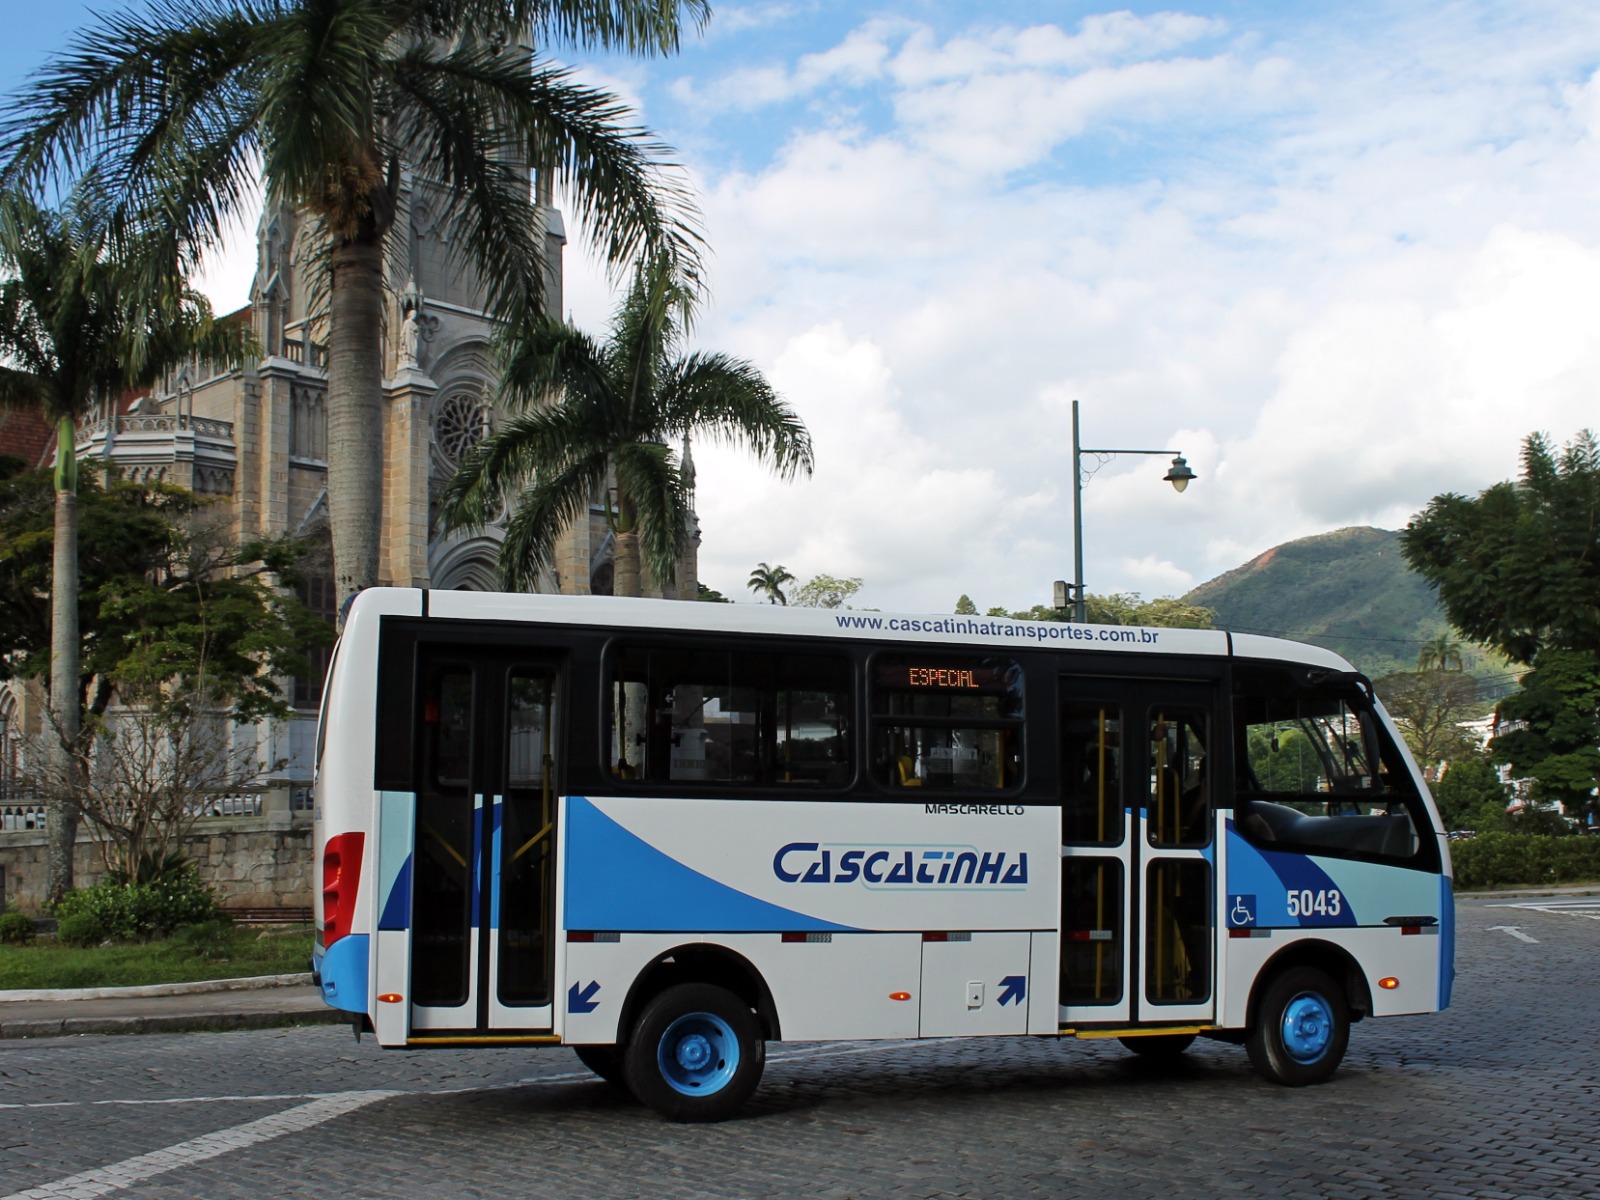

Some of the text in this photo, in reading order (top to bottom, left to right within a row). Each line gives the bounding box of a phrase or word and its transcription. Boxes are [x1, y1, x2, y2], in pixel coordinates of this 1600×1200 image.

[835, 615, 1159, 643] www.cascatinhatransportes.com.br
[909, 667, 979, 688] ESPECIAL
[925, 804, 1025, 816] MASCARELLO
[1286, 889, 1341, 917] 5043
